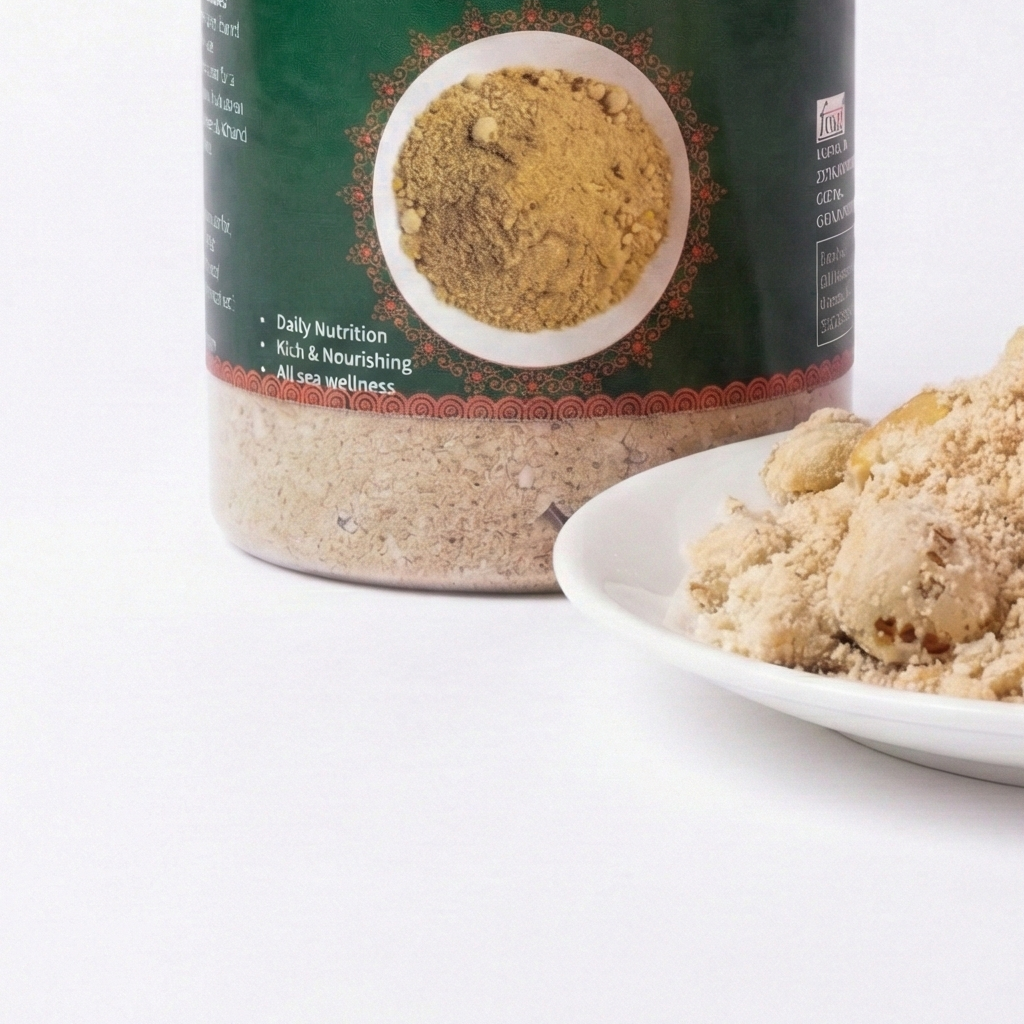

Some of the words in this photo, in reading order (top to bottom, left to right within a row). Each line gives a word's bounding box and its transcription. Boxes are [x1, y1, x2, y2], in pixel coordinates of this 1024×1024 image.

[277, 314, 311, 339] Daily
[315, 320, 387, 344] Nutrition
[308, 345, 319, 362] &
[323, 347, 412, 375] Nourishing
[277, 364, 294, 382] All
[325, 374, 396, 395] wellness
